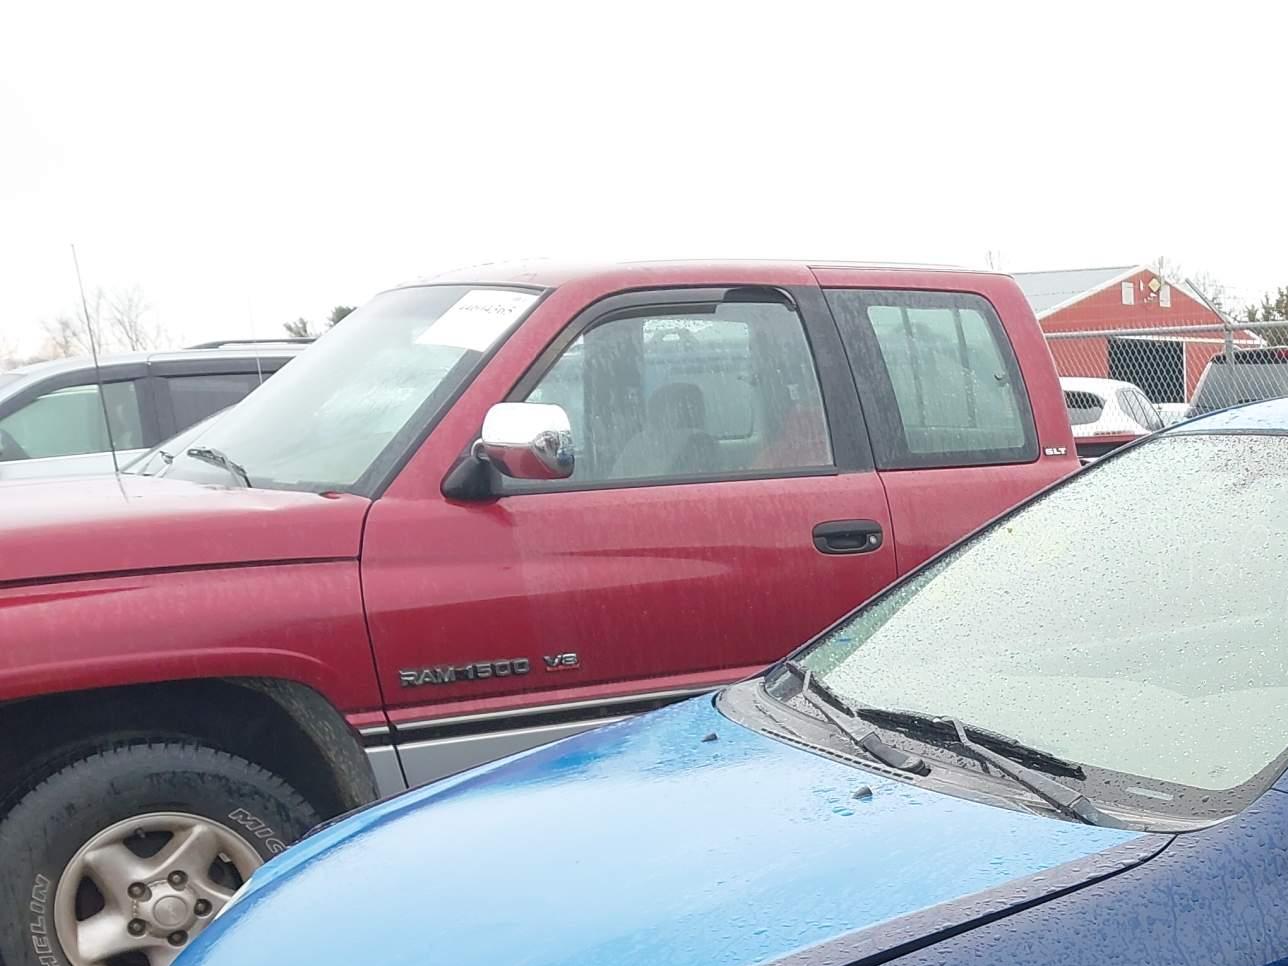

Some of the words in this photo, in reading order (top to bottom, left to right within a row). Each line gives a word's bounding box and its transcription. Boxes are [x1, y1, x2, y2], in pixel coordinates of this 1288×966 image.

[1044, 447, 1067, 456] SLT
[399, 665, 457, 687] RAM
[464, 657, 530, 681] 1500
